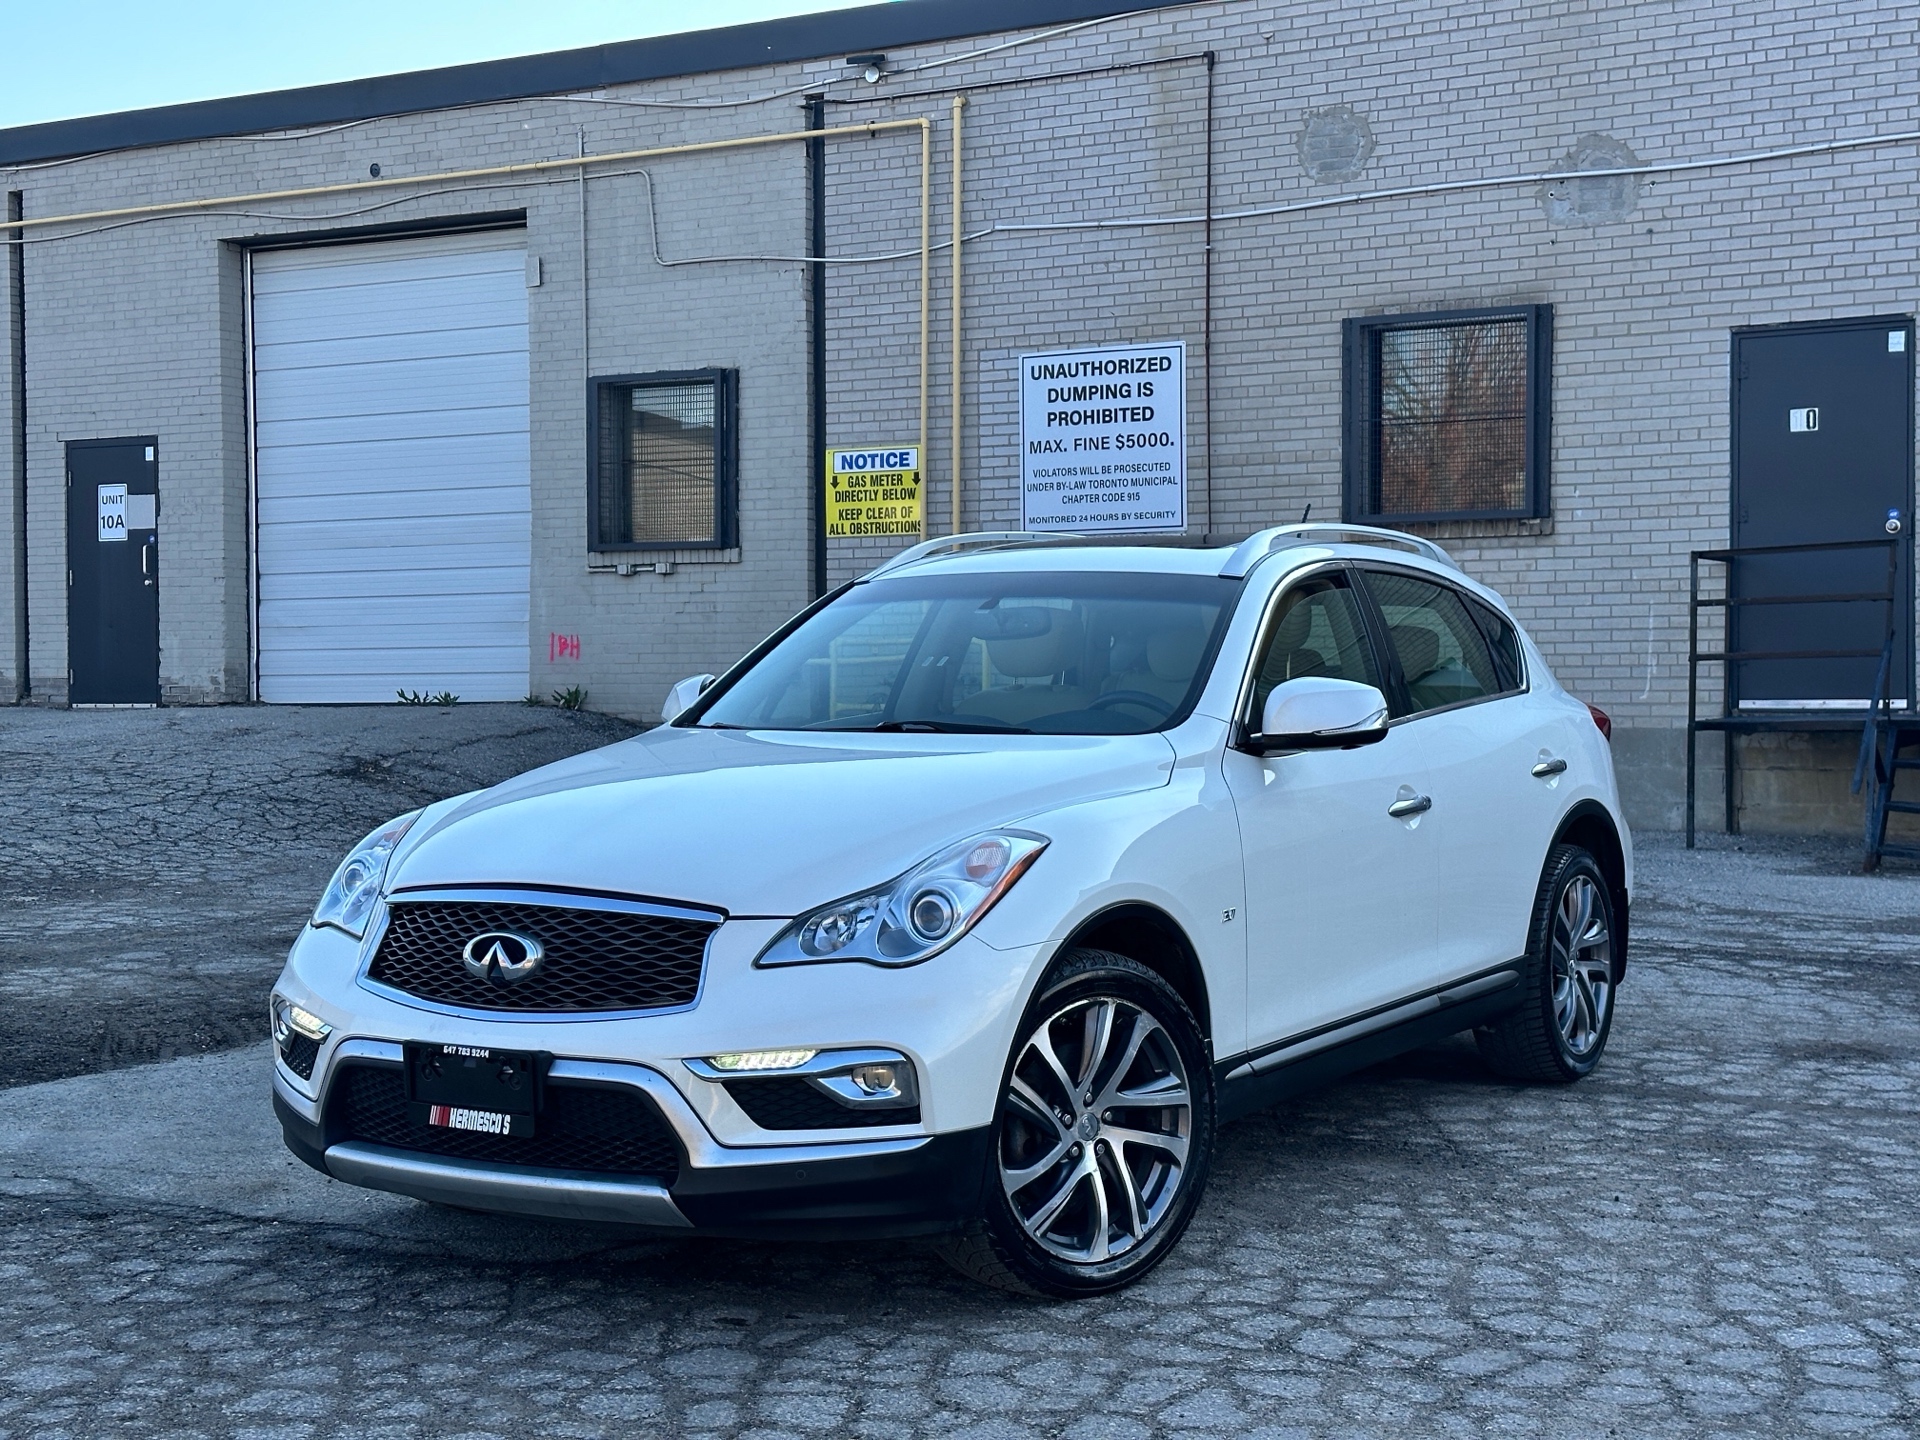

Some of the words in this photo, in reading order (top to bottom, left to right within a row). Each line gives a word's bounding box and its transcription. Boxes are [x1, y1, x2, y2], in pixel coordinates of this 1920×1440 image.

[1031, 356, 1172, 380] UNAUTHORIZED
[1047, 383, 1131, 403] DUMPING
[1137, 382, 1154, 397] IS
[1047, 406, 1154, 427] PROHIBITED
[1029, 439, 1067, 454] MAX.
[1073, 436, 1110, 451] FINE
[1115, 432, 1174, 450] $5000.
[841, 452, 910, 470] NOTICE
[1033, 467, 1077, 478] VIOLATORS
[1080, 466, 1099, 475] WILL
[1101, 465, 1112, 474] BE
[1114, 462, 1170, 473] PROSECUTED
[847, 475, 867, 488] GAS
[870, 473, 903, 487] METER
[1027, 482, 1054, 492] UNDER
[1056, 480, 1087, 490] BY-LAW
[1089, 478, 1128, 489] TORONTO
[1130, 476, 1178, 487] MUNICIPAL
[101, 494, 124, 505] UNIT
[835, 489, 879, 503] DIRECTLY
[882, 487, 916, 501] BELOW
[1062, 494, 1099, 504] CHAPTER
[1102, 493, 1125, 503] CODE
[1127, 491, 1140, 501] 915
[101, 514, 125, 529] 10A
[838, 508, 862, 521] KEEP
[866, 506, 897, 520] CLEAR
[900, 506, 913, 519] OF
[1029, 515, 1077, 524] MONITORED
[1079, 514, 1088, 522] 24
[1090, 513, 1119, 521] HOURS
[1121, 512, 1132, 520] BY
[1134, 511, 1176, 520] SECURITY
[829, 523, 847, 536] ALL
[443, 1045, 456, 1054] 647
[471, 1048, 490, 1058] 9244
[448, 1107, 511, 1135] HERMESCO'S
